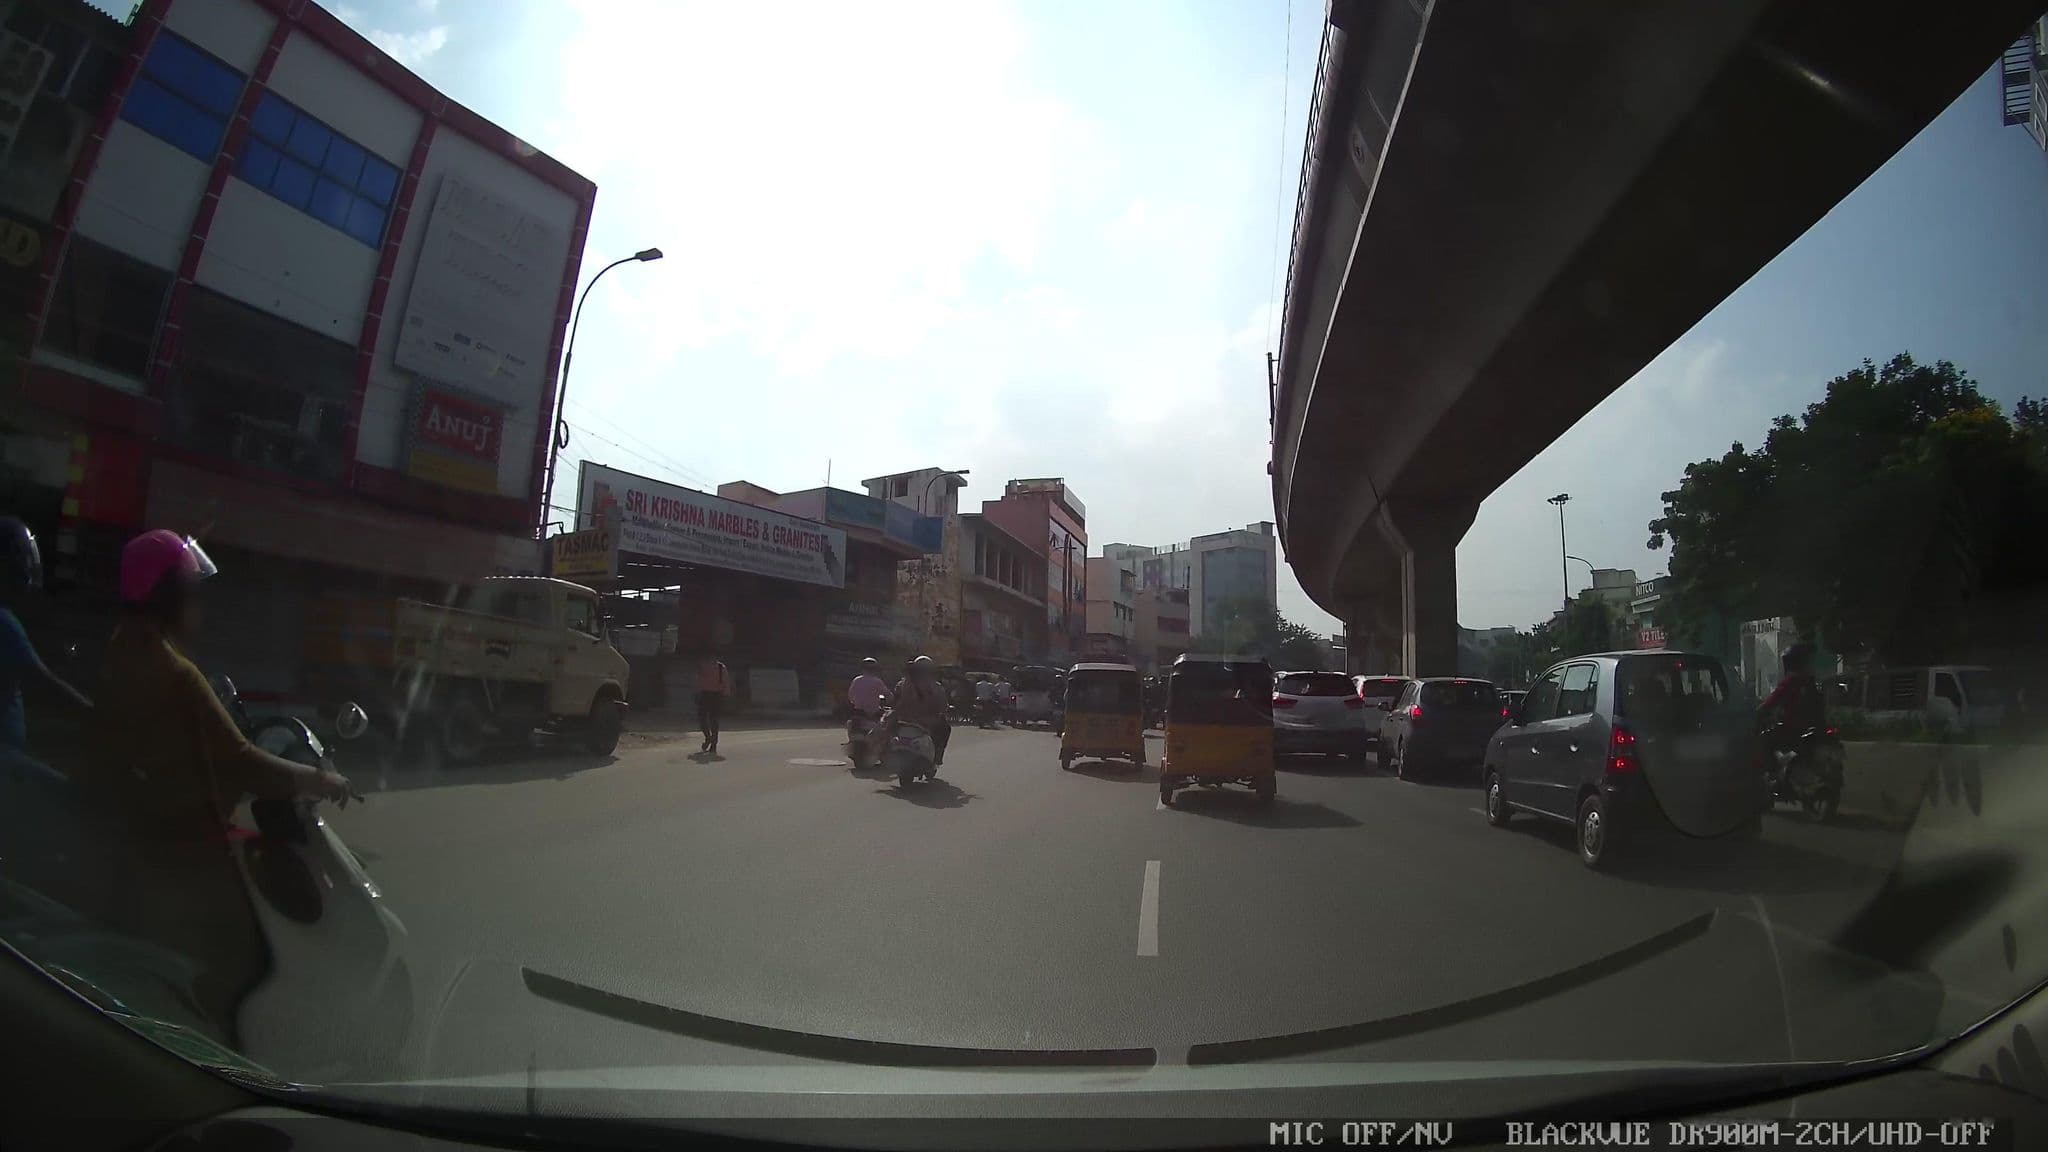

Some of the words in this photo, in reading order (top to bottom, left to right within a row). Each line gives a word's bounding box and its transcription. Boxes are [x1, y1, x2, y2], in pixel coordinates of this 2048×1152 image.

[626, 489, 647, 514] SRI
[651, 495, 705, 528] KRISHNA
[708, 508, 759, 539] MARBLES
[762, 521, 769, 541] &
[773, 525, 820, 552] GRANITES
[556, 531, 608, 556] TASMAC
[1635, 582, 1654, 597] NITCO
